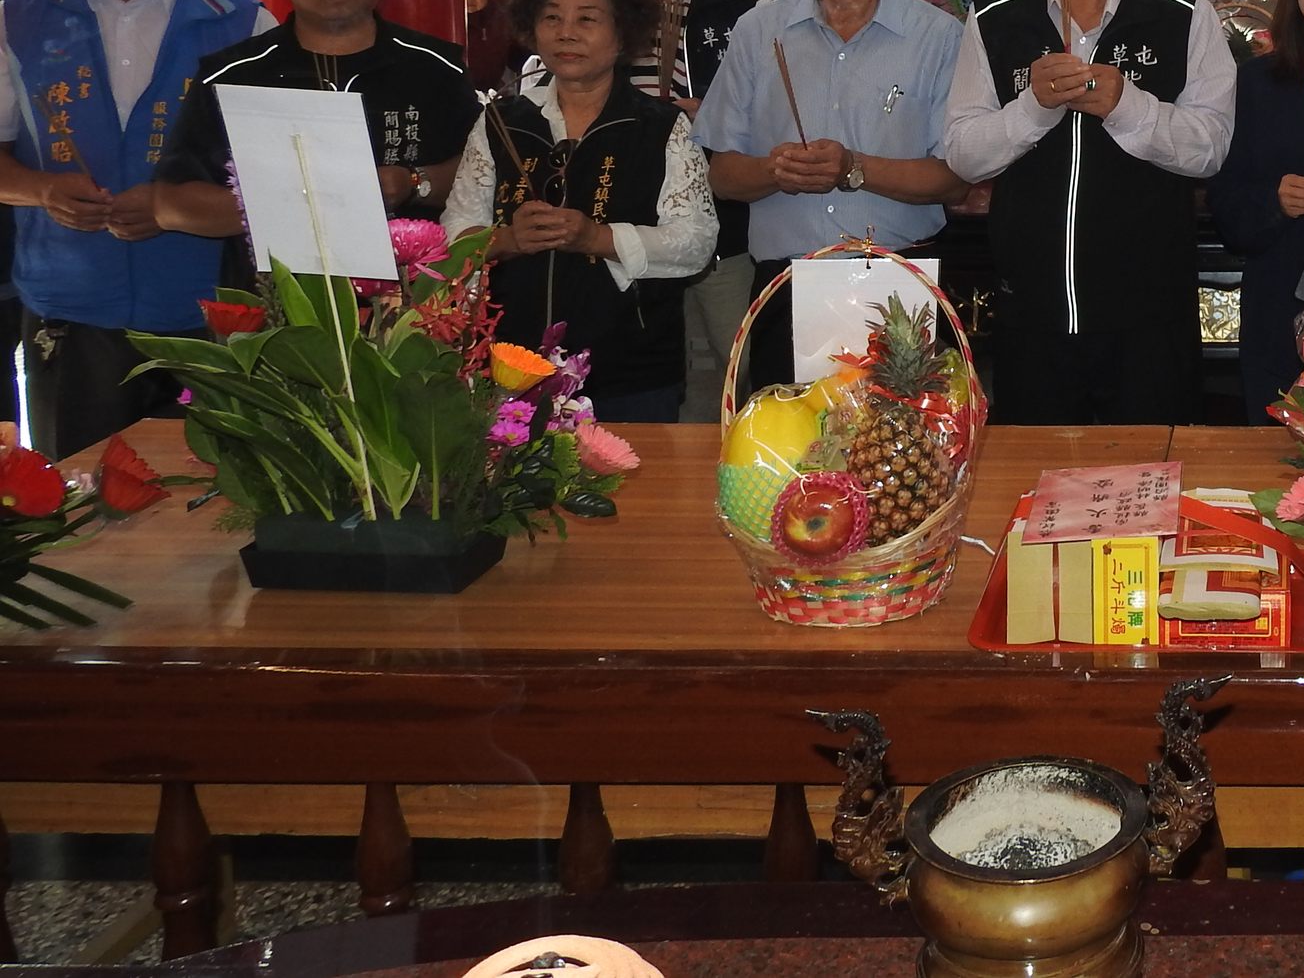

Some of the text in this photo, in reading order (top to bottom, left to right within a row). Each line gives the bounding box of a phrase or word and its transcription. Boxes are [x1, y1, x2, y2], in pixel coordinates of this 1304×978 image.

[1109, 44, 1158, 67] 草屯
[1110, 558, 1127, 635] 二斤斗燭
